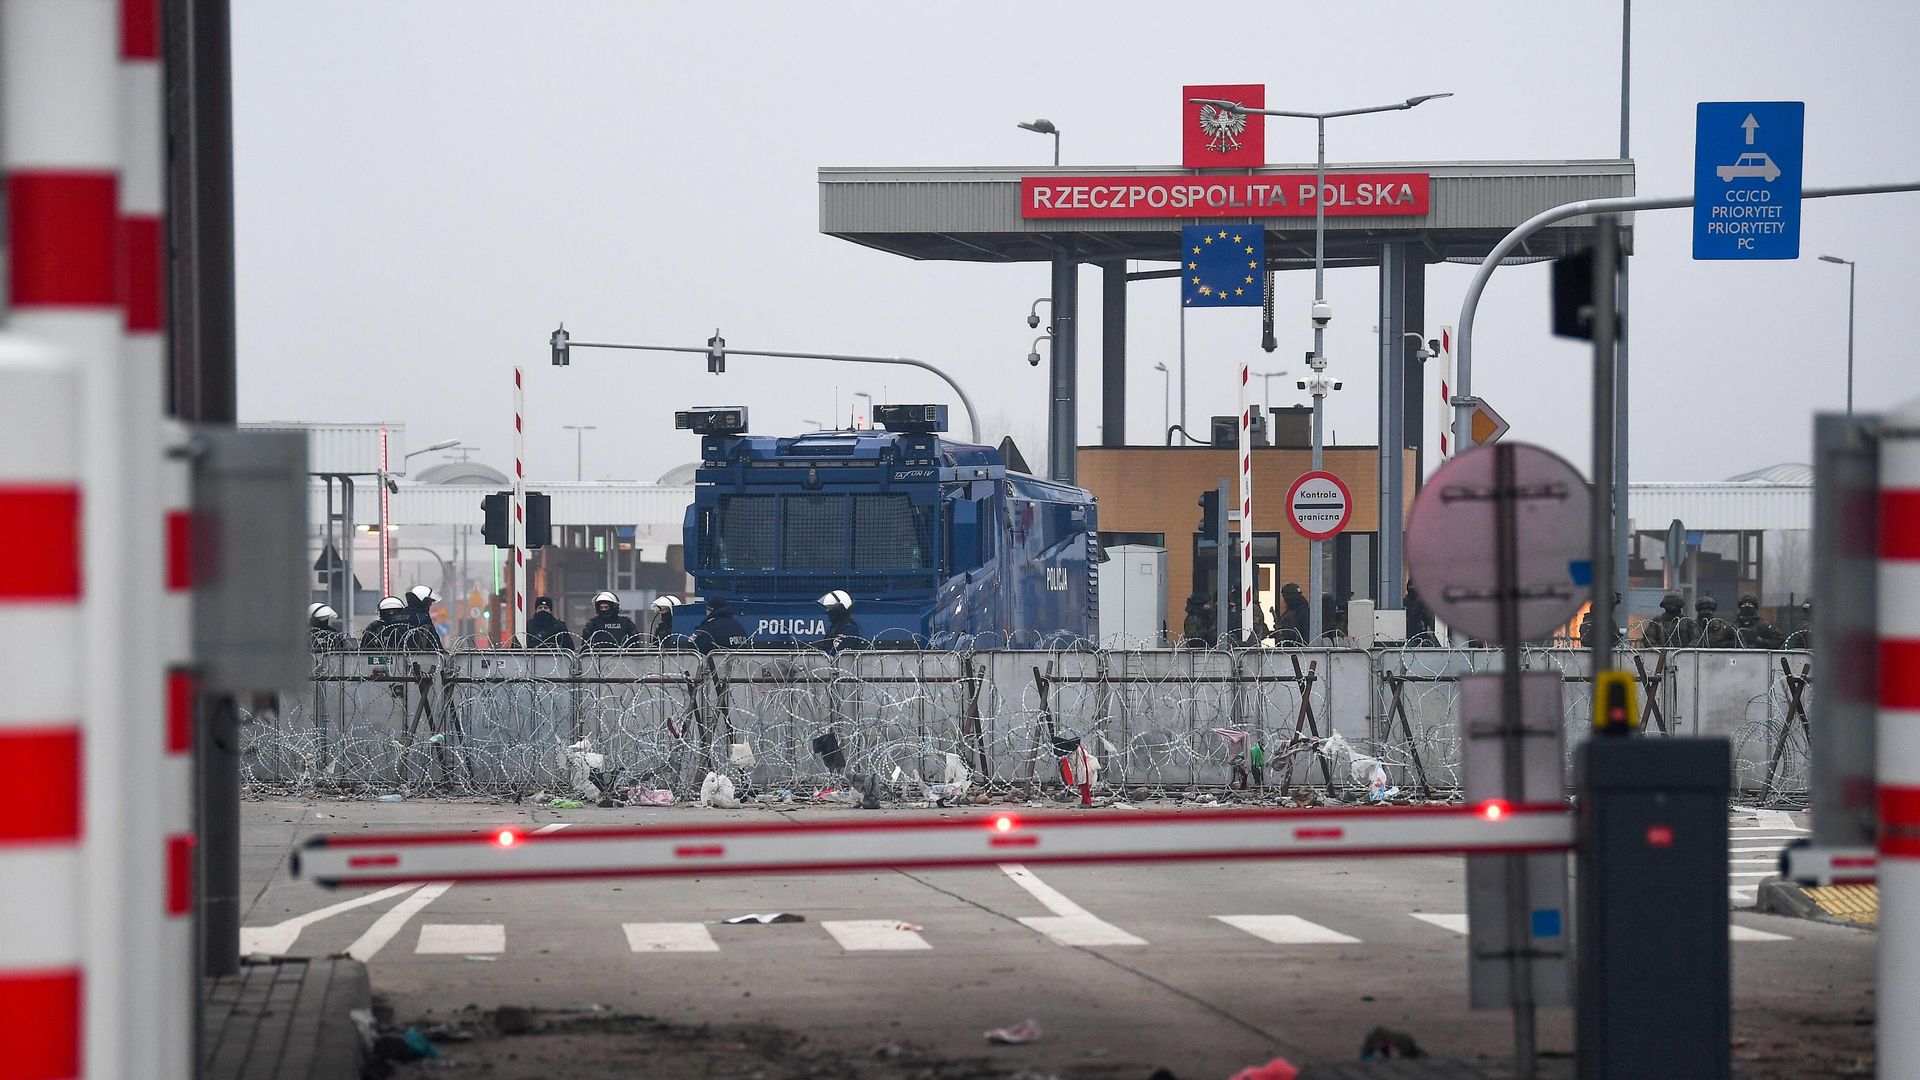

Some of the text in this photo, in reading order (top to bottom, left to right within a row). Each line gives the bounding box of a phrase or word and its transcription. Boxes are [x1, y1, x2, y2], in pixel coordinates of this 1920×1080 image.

[1033, 182, 1416, 209] RZECZPOSPOLITA POLSKA
[1725, 190, 1771, 202] CC/CD
[1712, 206, 1782, 218] PRIORYTET
[1708, 222, 1785, 234] PRIORYTETY
[1738, 238, 1754, 249] PC
[1300, 490, 1337, 499] Kontrola
[1298, 512, 1340, 523] graniczna
[1046, 567, 1068, 591] POLICJA
[758, 619, 827, 636] POLICJA
